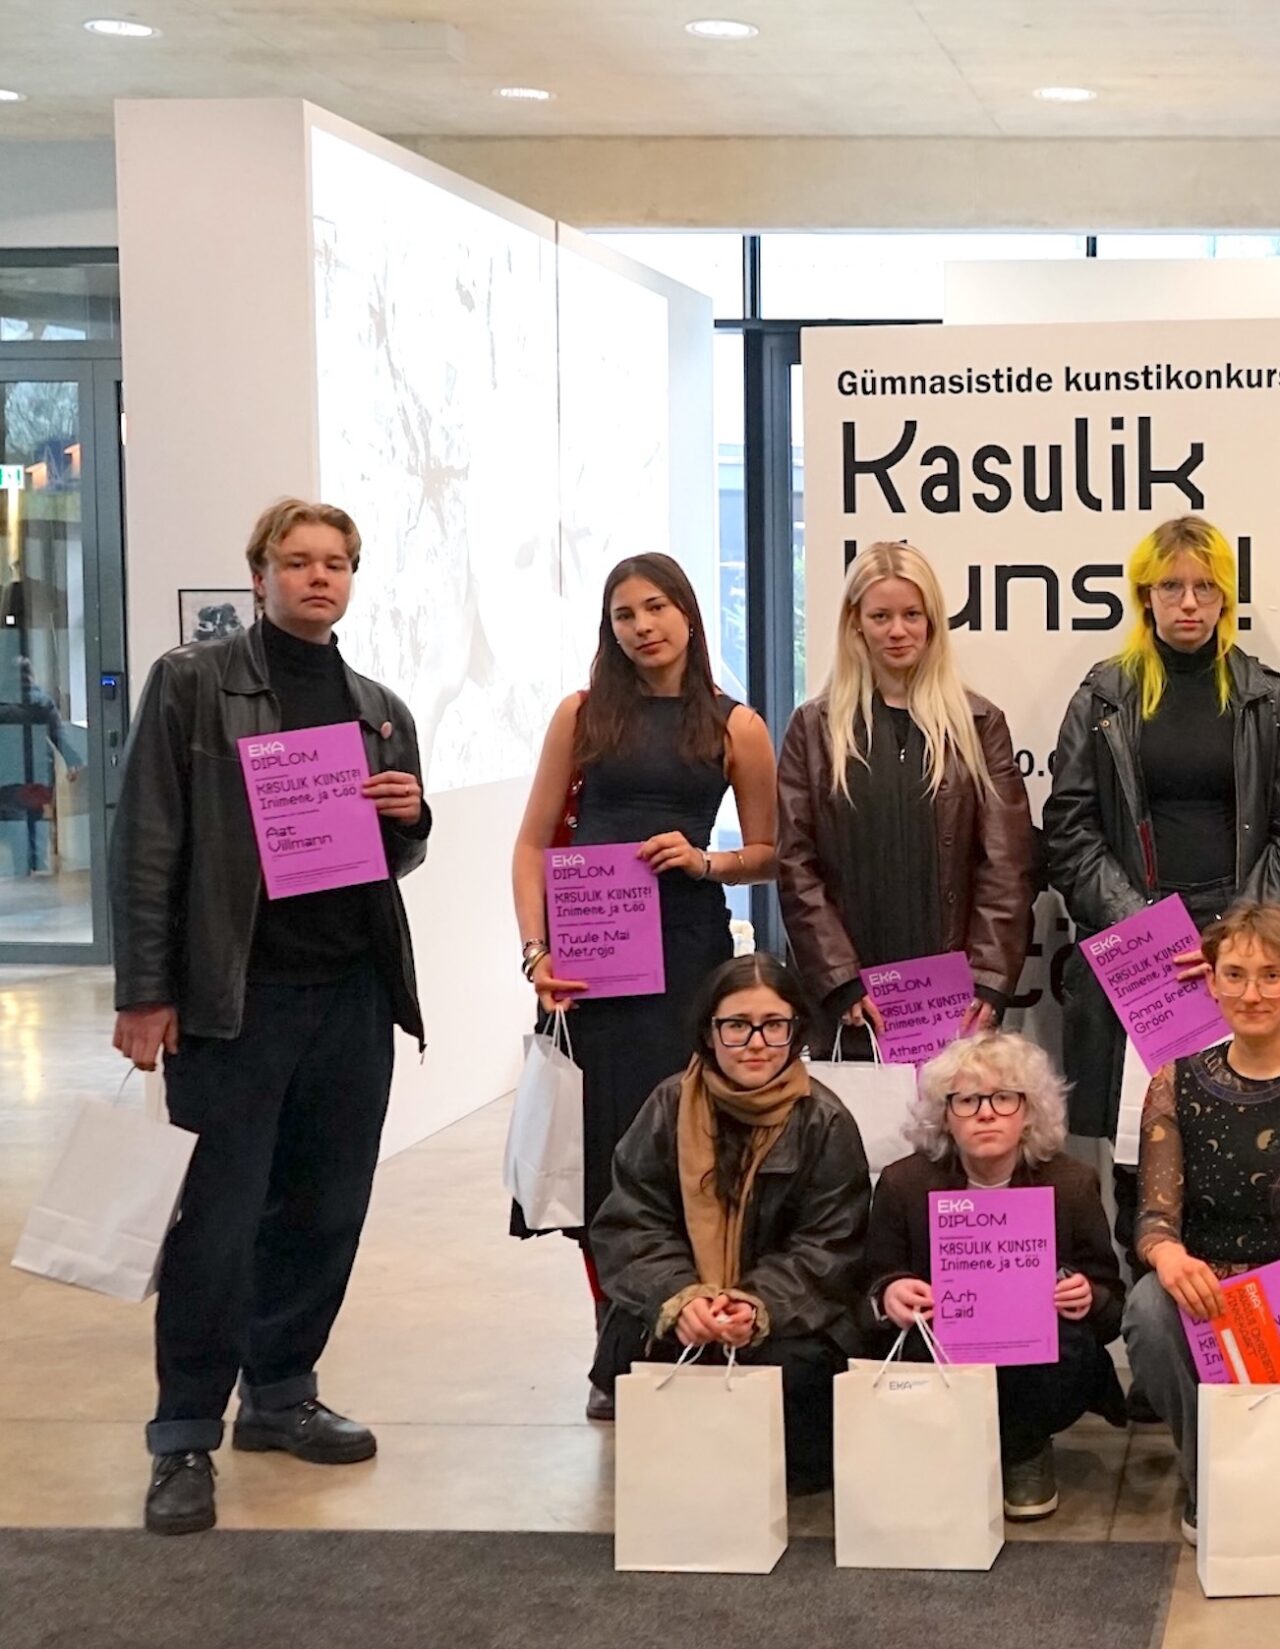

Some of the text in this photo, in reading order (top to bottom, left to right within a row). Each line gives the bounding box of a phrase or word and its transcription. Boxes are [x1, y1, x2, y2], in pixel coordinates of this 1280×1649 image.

[836, 368, 1054, 396] Gümnasistide
[842, 416, 1205, 514] Kasulik
[248, 741, 285, 758] EKA
[251, 750, 319, 771] DIPLOM
[261, 794, 315, 810] Inimene
[318, 789, 329, 804] ja
[552, 854, 585, 867] EKA
[553, 865, 615, 880] DIPLOM
[557, 904, 606, 917] Inimene
[608, 903, 619, 917] ja
[558, 933, 599, 945] Tuule
[1089, 934, 1122, 956] EKA
[1096, 931, 1154, 967] DIPLOM
[869, 970, 901, 986] EKA
[1114, 964, 1173, 998] Inimene ja
[872, 977, 932, 998] DIPLOM
[1129, 1001, 1163, 1022] Anna
[884, 1015, 930, 1032] Inimene
[932, 1012, 942, 1026] ja
[938, 1199, 974, 1213] EKA
[938, 1213, 1007, 1228] DIPLOM
[941, 1257, 996, 1271] Inimene
[997, 1256, 1010, 1272] ja
[942, 1307, 974, 1319] Laid
